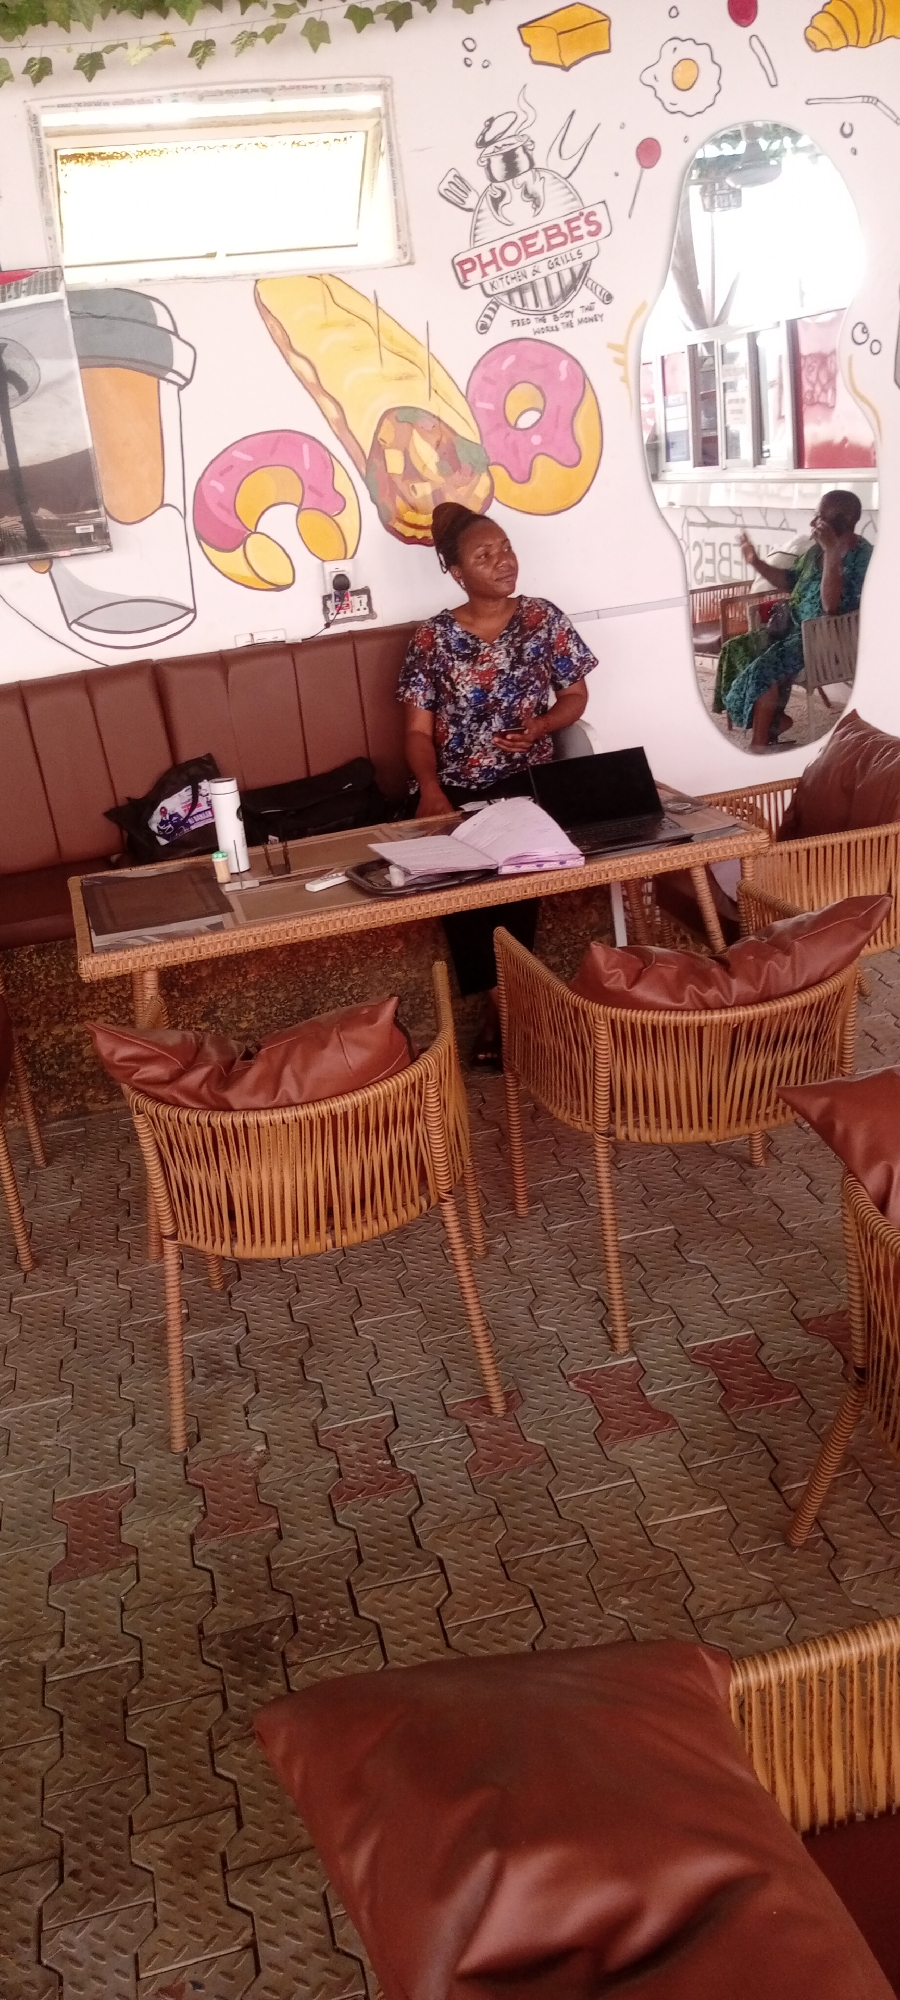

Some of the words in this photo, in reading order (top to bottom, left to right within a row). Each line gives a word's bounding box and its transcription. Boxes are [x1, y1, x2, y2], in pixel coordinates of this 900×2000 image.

[456, 210, 603, 283] PHOEBE'S
[489, 268, 528, 291] KITCHEN
[532, 265, 541, 277] &
[547, 249, 583, 270] GRILLS
[510, 315, 531, 328] FEED
[534, 315, 547, 324] THE
[553, 309, 575, 322] BODY
[580, 302, 596, 313] THAT
[533, 325, 560, 336] WORKS
[561, 320, 574, 330] THE
[577, 313, 604, 326] MONEY
